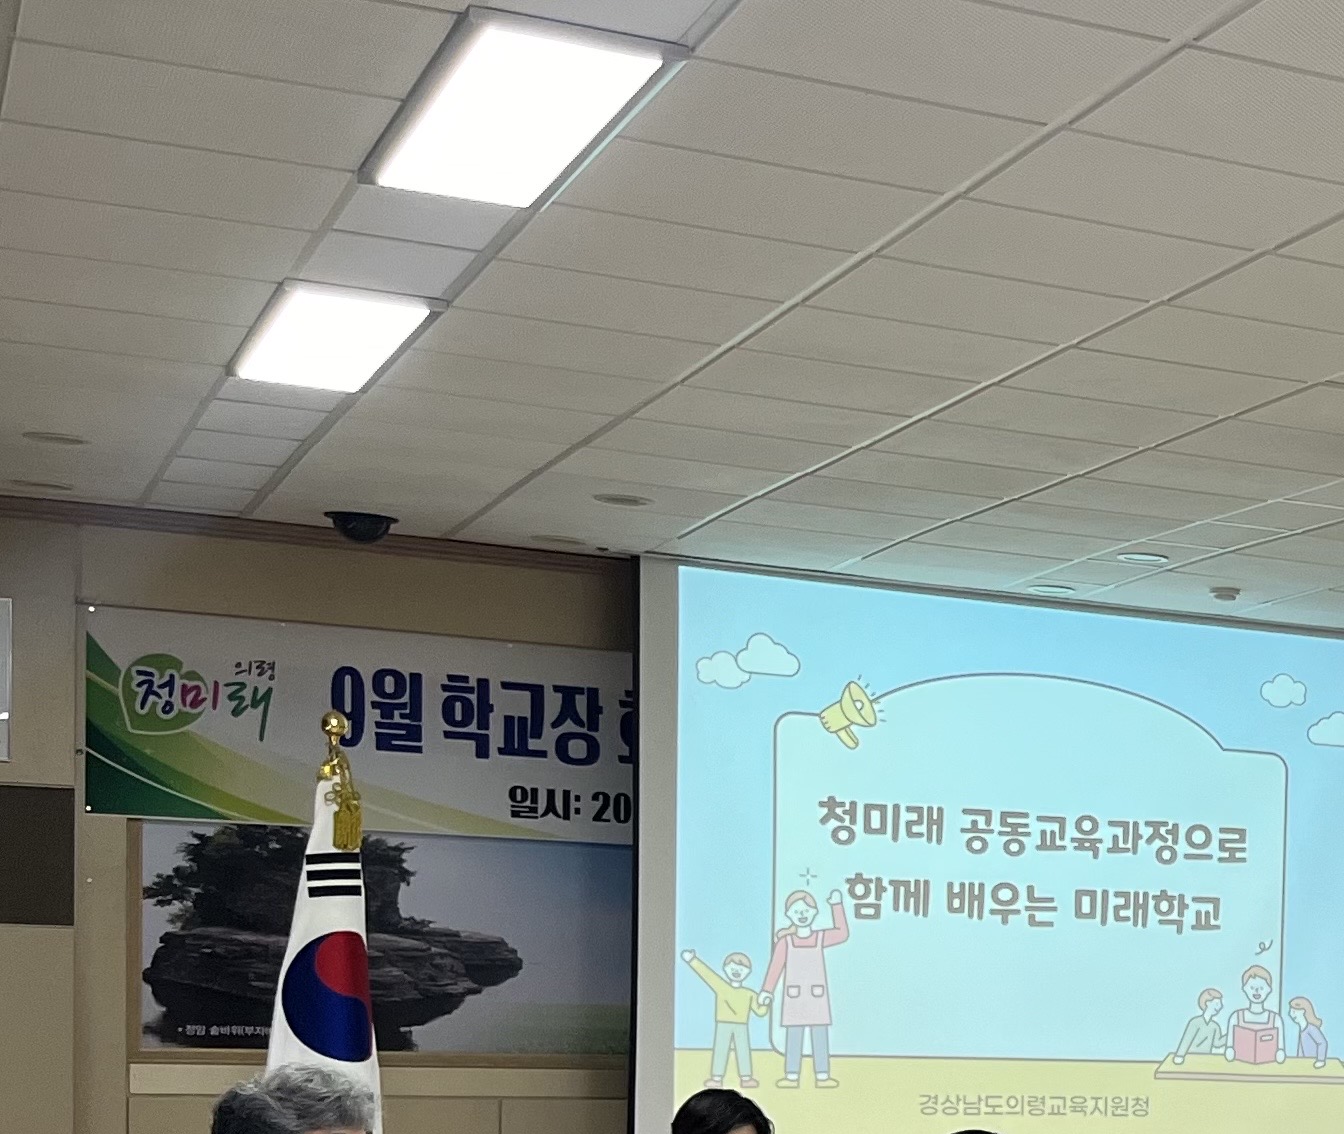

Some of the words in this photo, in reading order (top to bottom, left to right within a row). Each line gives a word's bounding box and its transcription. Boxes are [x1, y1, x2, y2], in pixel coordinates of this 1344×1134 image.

[234, 660, 276, 682] 의령
[134, 669, 273, 742] 청미래
[330, 665, 423, 755] 9월
[440, 673, 604, 767] 학교장
[508, 784, 582, 821] 일시:
[818, 795, 945, 847] 청미래
[959, 807, 1248, 866] 공동교육과정으로
[845, 872, 931, 921] 함께
[946, 880, 1058, 929] 배우는
[1073, 888, 1222, 936] 미래학교
[918, 1093, 1150, 1118] 경상남도의령교육지원청
